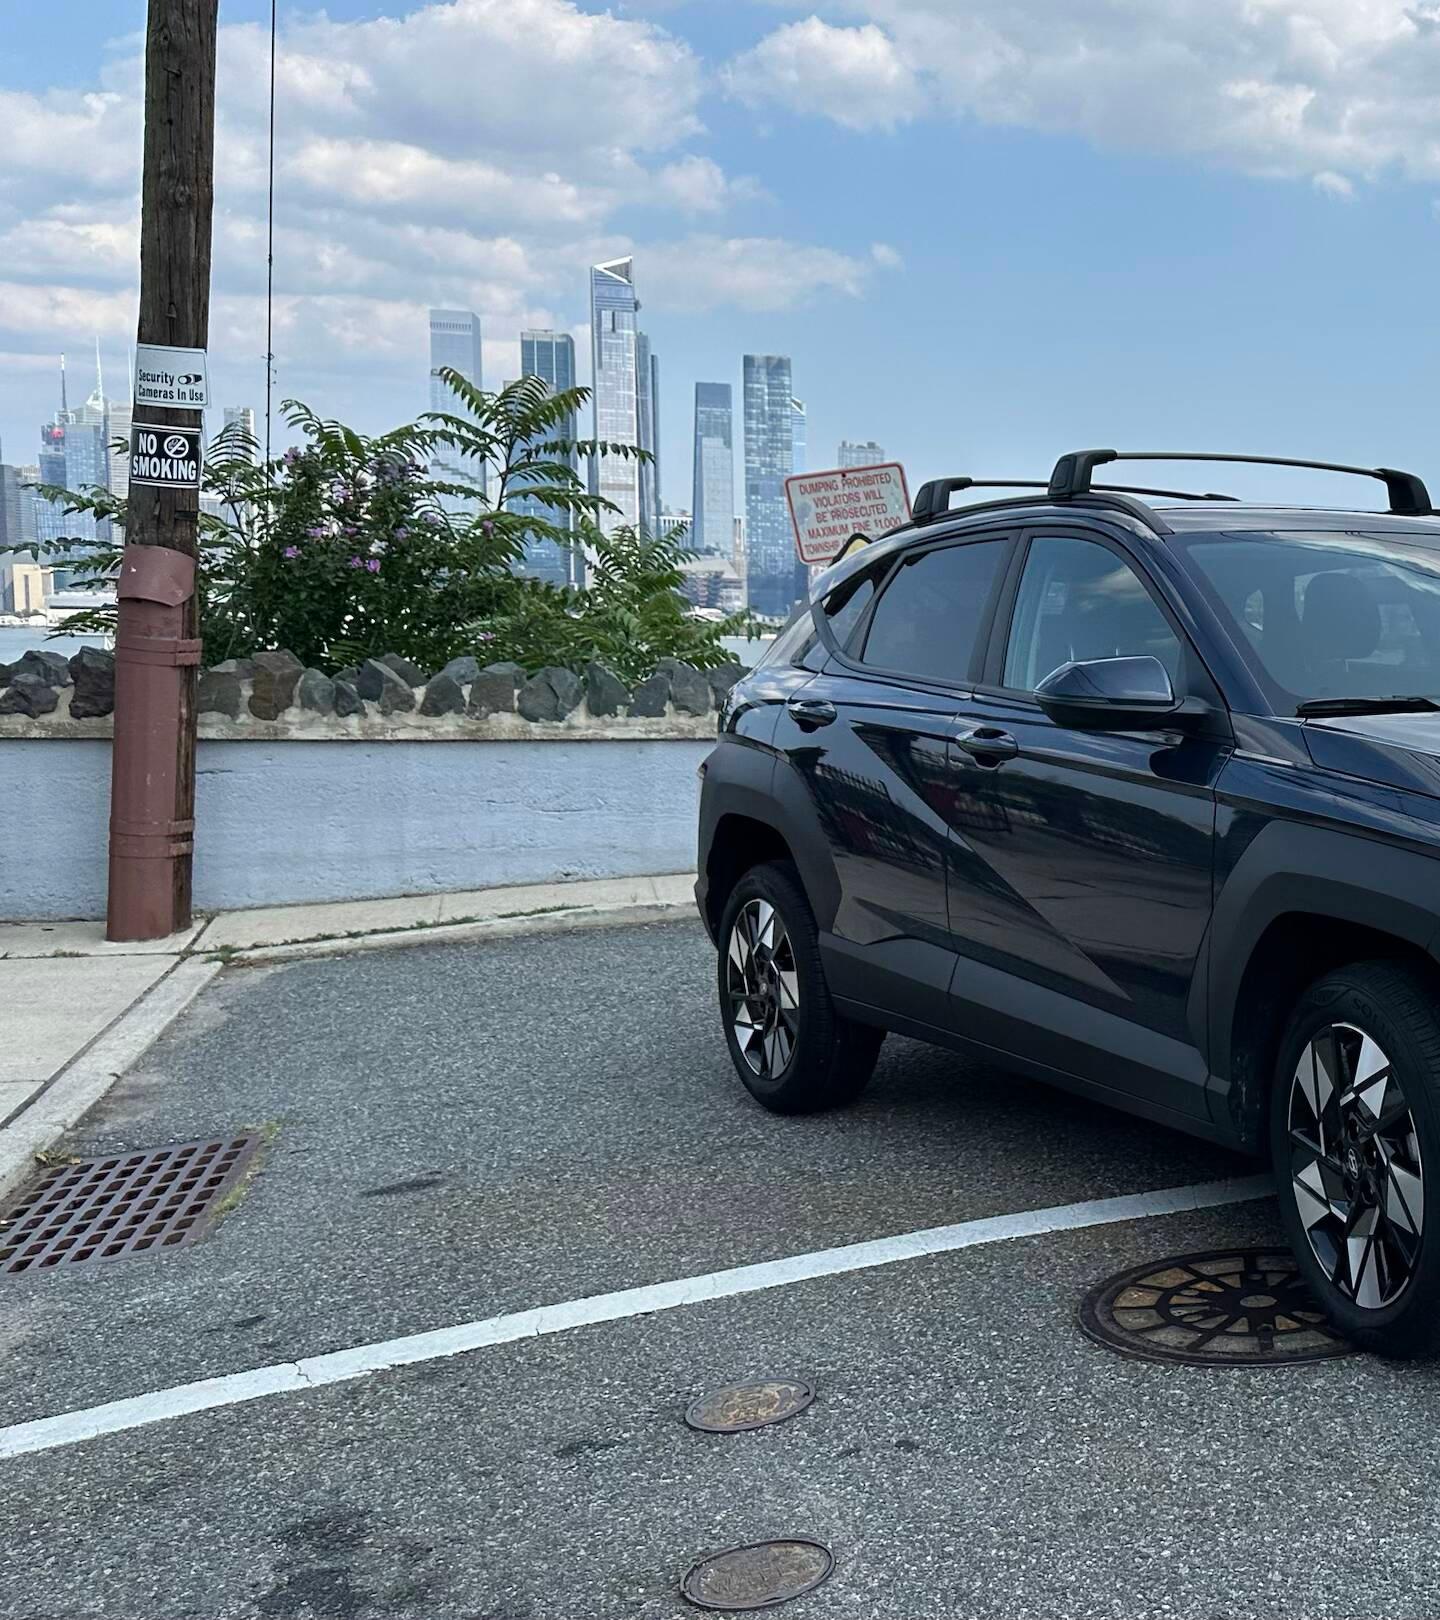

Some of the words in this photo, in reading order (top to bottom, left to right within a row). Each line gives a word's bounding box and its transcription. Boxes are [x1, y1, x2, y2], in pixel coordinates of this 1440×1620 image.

[138, 369, 175, 387] Security
[138, 384, 174, 400] Cameras
[177, 388, 187, 400] In
[189, 389, 204, 402] Use
[138, 433, 157, 455] NO
[132, 456, 197, 480] SMOKING
[799, 480, 839, 495] DUMPING
[842, 472, 892, 488] PROHIBITED
[813, 492, 861, 508] VIOLATORS
[864, 489, 884, 501] WILL
[815, 511, 829, 523] BE
[831, 503, 888, 521] PROSECUTED
[807, 524, 849, 539] MAXIMUM
[852, 521, 872, 533] FINE
